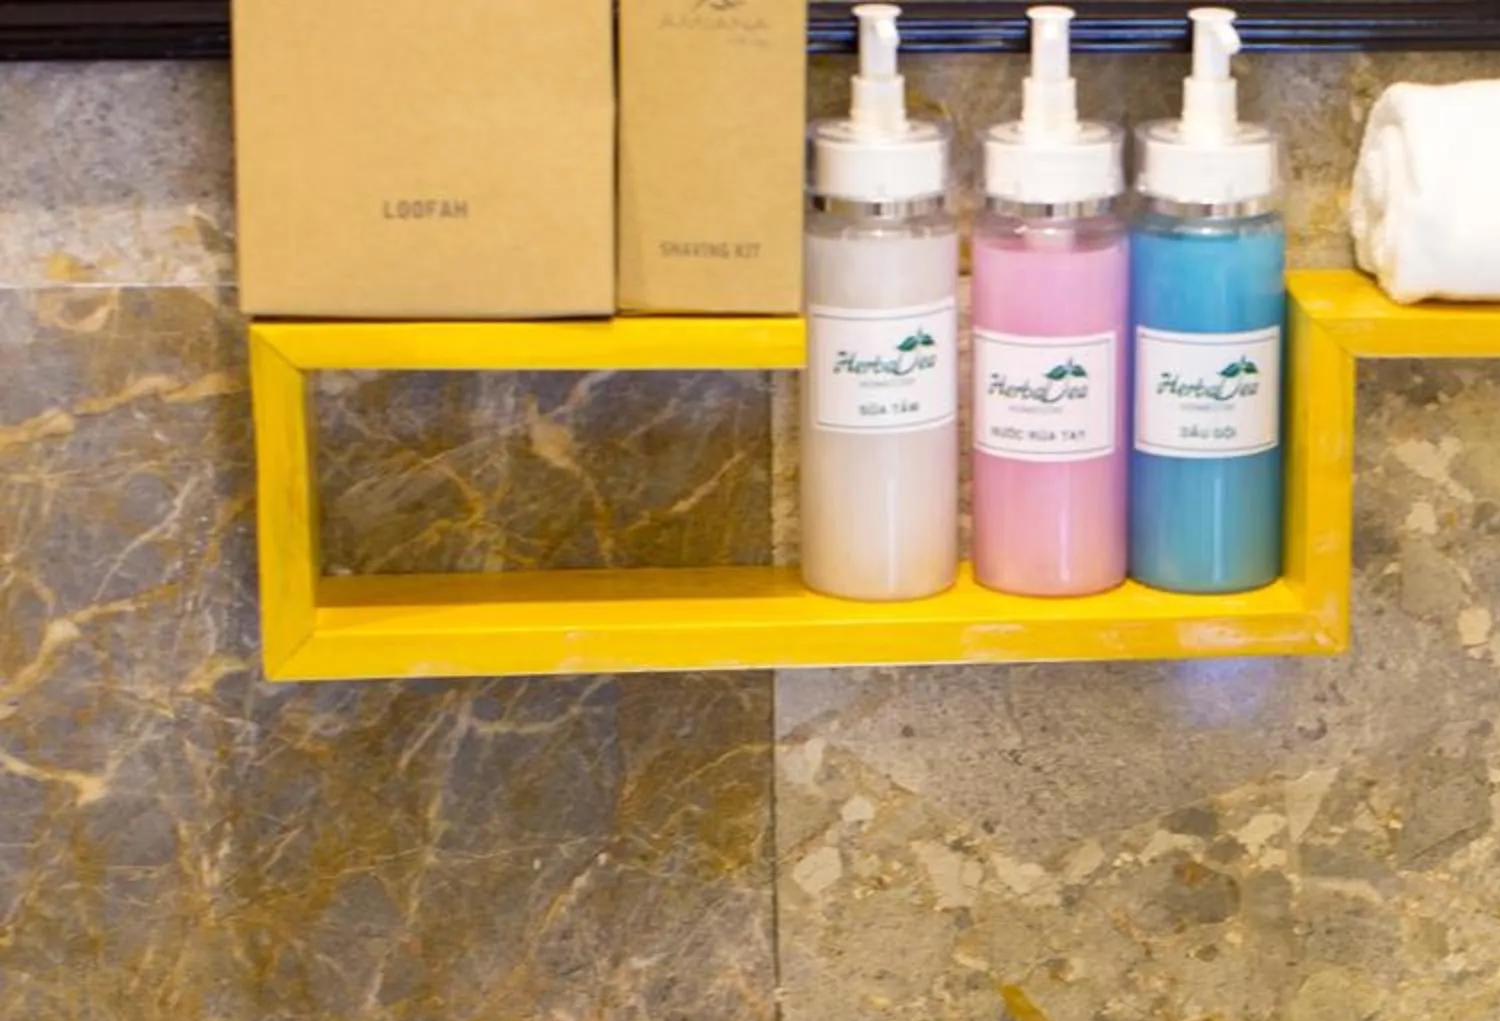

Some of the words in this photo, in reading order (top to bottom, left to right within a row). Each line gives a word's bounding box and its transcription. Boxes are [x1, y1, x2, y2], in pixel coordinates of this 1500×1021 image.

[383, 199, 468, 219] LOOFAH
[659, 240, 730, 259] SHAVING
[735, 241, 763, 259] KIT
